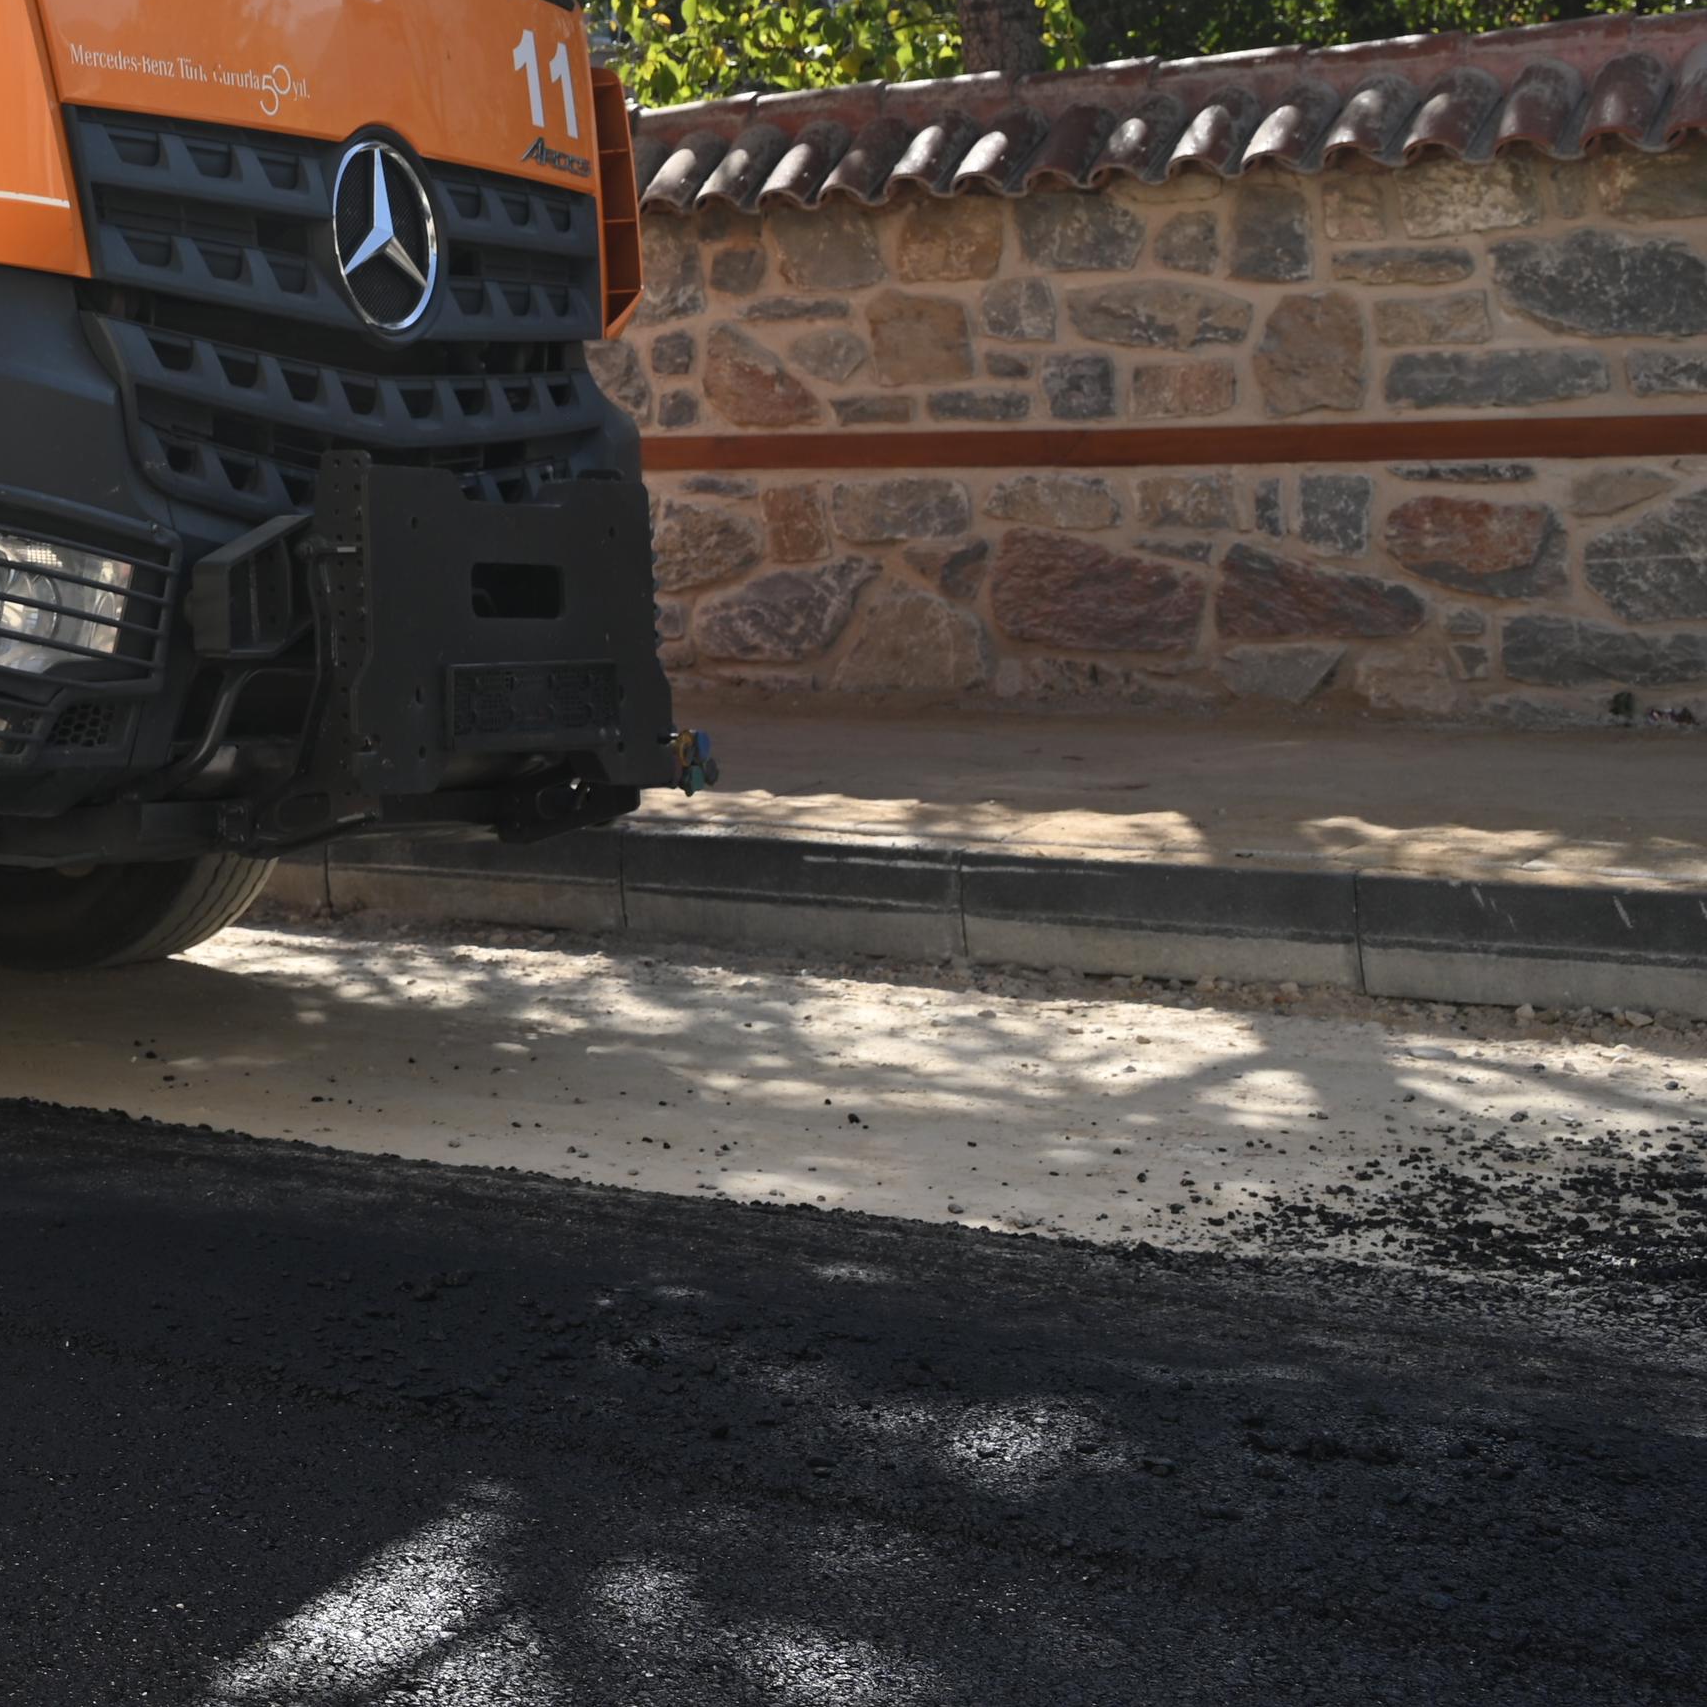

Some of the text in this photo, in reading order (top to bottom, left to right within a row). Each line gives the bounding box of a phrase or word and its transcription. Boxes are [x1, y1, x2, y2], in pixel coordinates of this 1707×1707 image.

[70, 43, 175, 78] Mercedes-Benz
[260, 64, 291, 116] 50
[513, 29, 579, 139] 11
